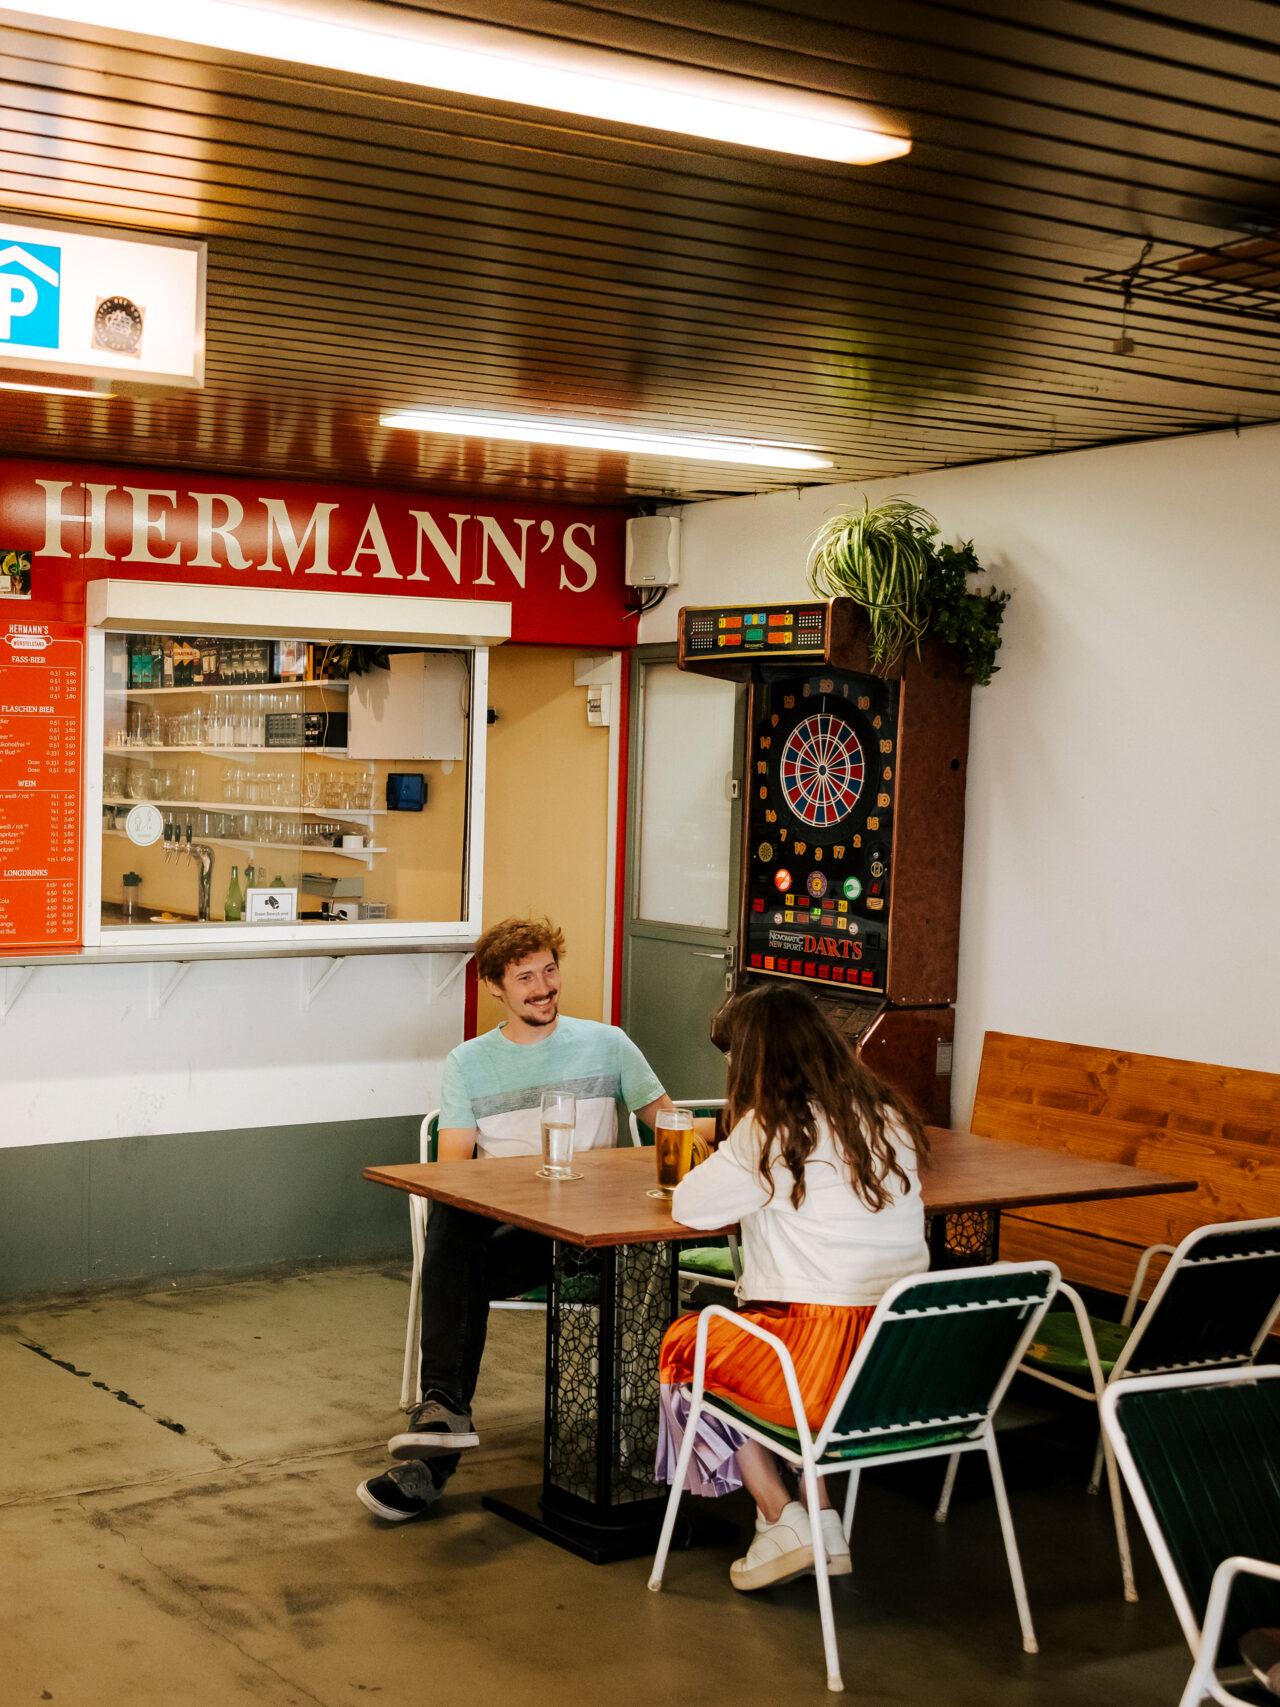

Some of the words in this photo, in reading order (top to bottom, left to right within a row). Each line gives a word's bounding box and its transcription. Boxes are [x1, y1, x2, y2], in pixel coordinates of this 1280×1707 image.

[35, 479, 596, 593] HERMANN'S
[9, 624, 48, 634] HERMANN'S
[12, 656, 46, 664] FASS-BIER
[843, 684, 848, 698] 1
[1, 705, 38, 713] FLASCHEN
[771, 714, 779, 727] 9
[873, 715, 882, 729] 4
[760, 737, 771, 749] 14
[757, 761, 767, 774] 11
[883, 766, 892, 780] 6
[760, 786, 767, 799] 8
[877, 793, 890, 807] 10
[765, 810, 777, 823] 16
[867, 817, 879, 831] 15
[780, 829, 787, 842] 7
[853, 834, 861, 848] 2
[794, 842, 806, 855] 19
[815, 848, 822, 861] 3
[833, 846, 845, 859] 17
[3, 869, 48, 877] LONGDRINKS
[769, 932, 804, 944] NOVOMATIC
[769, 940, 783, 948] NEW
[804, 935, 862, 960] DARTS
